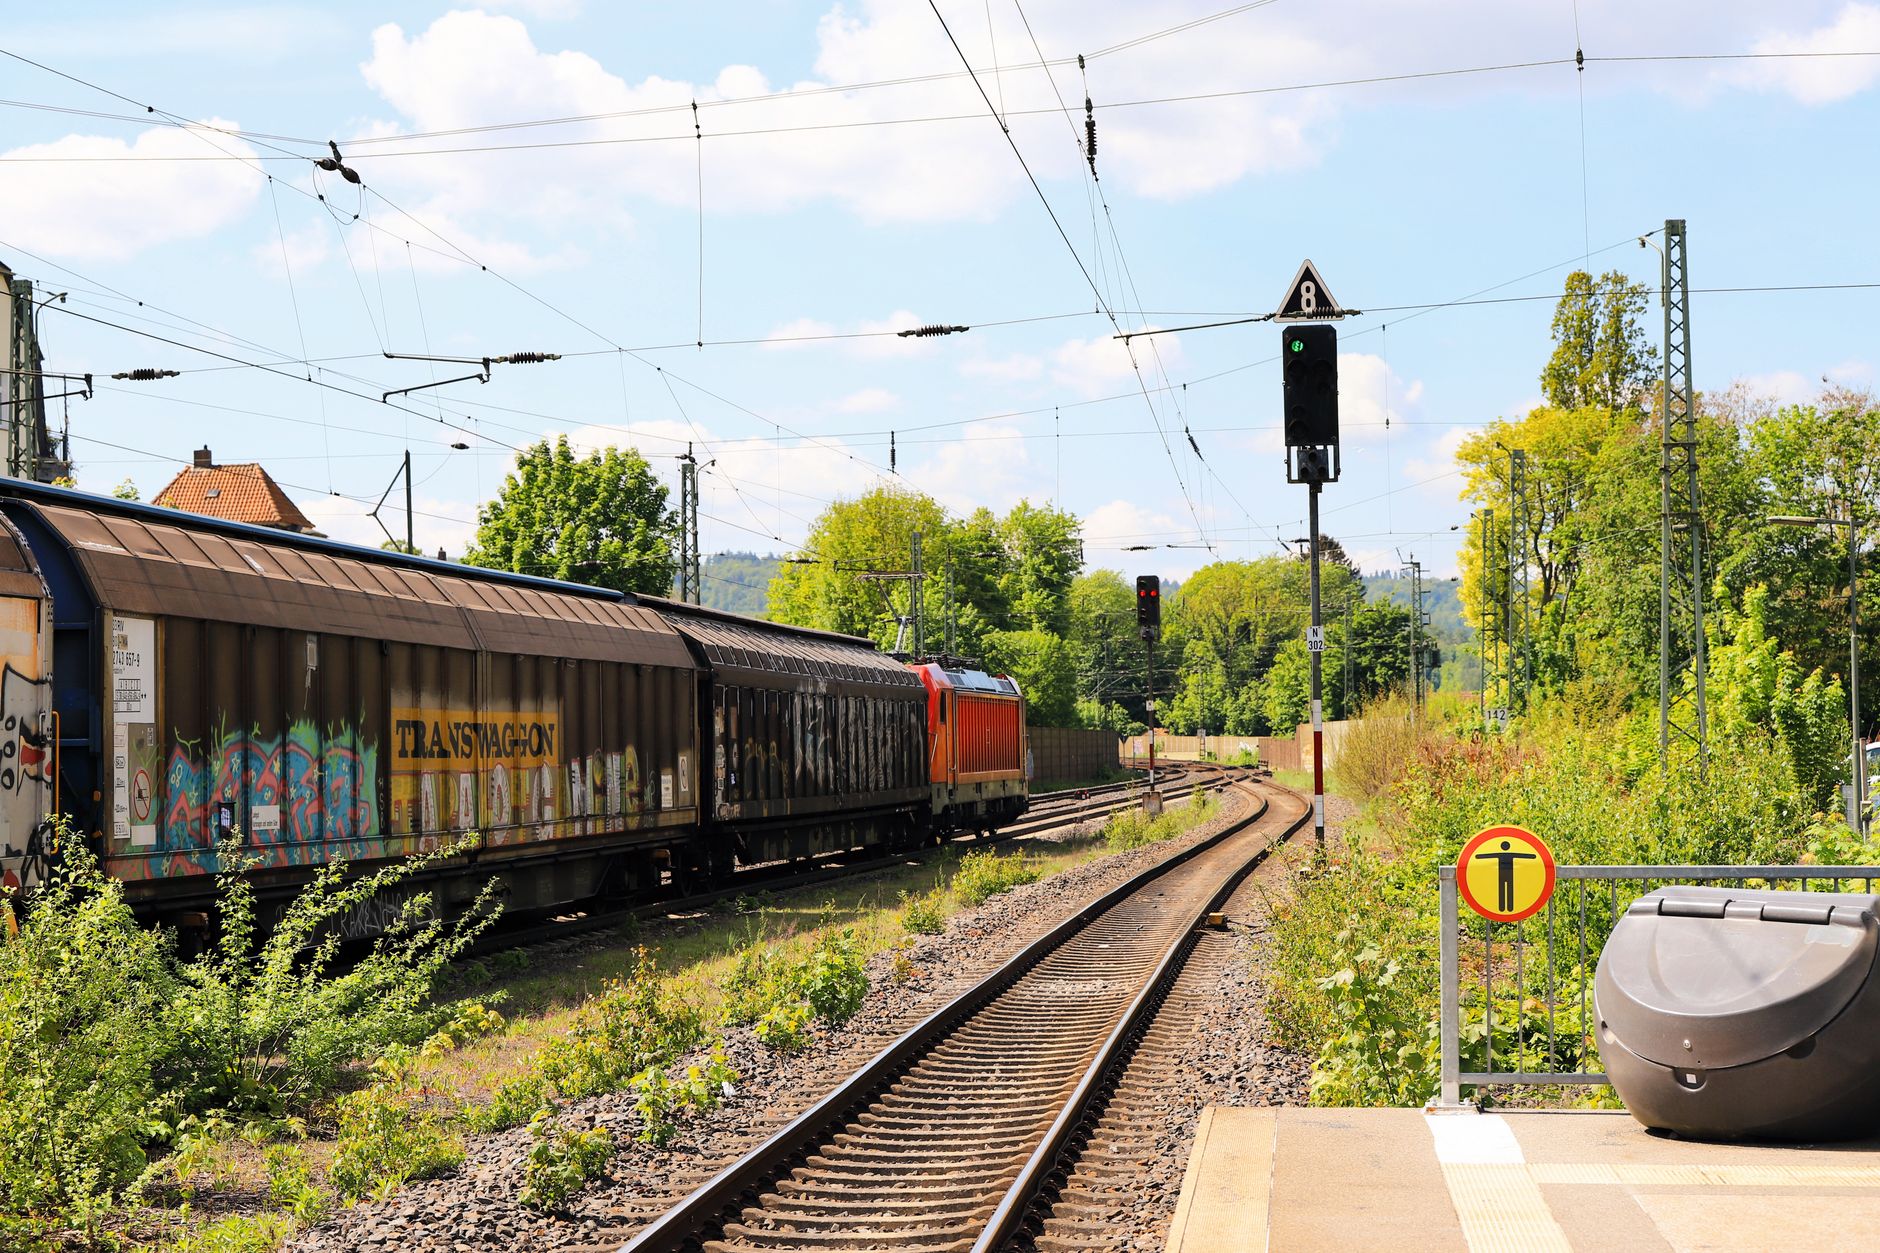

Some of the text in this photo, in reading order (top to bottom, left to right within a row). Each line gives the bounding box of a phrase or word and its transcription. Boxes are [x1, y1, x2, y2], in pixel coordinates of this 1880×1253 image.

[1301, 281, 1316, 311] 8
[1313, 628, 1318, 637] N
[1308, 640, 1323, 650] 302
[126, 652, 140, 667] 657-9
[1487, 710, 1506, 720] 112
[395, 719, 555, 760] TRANSWAGGON
